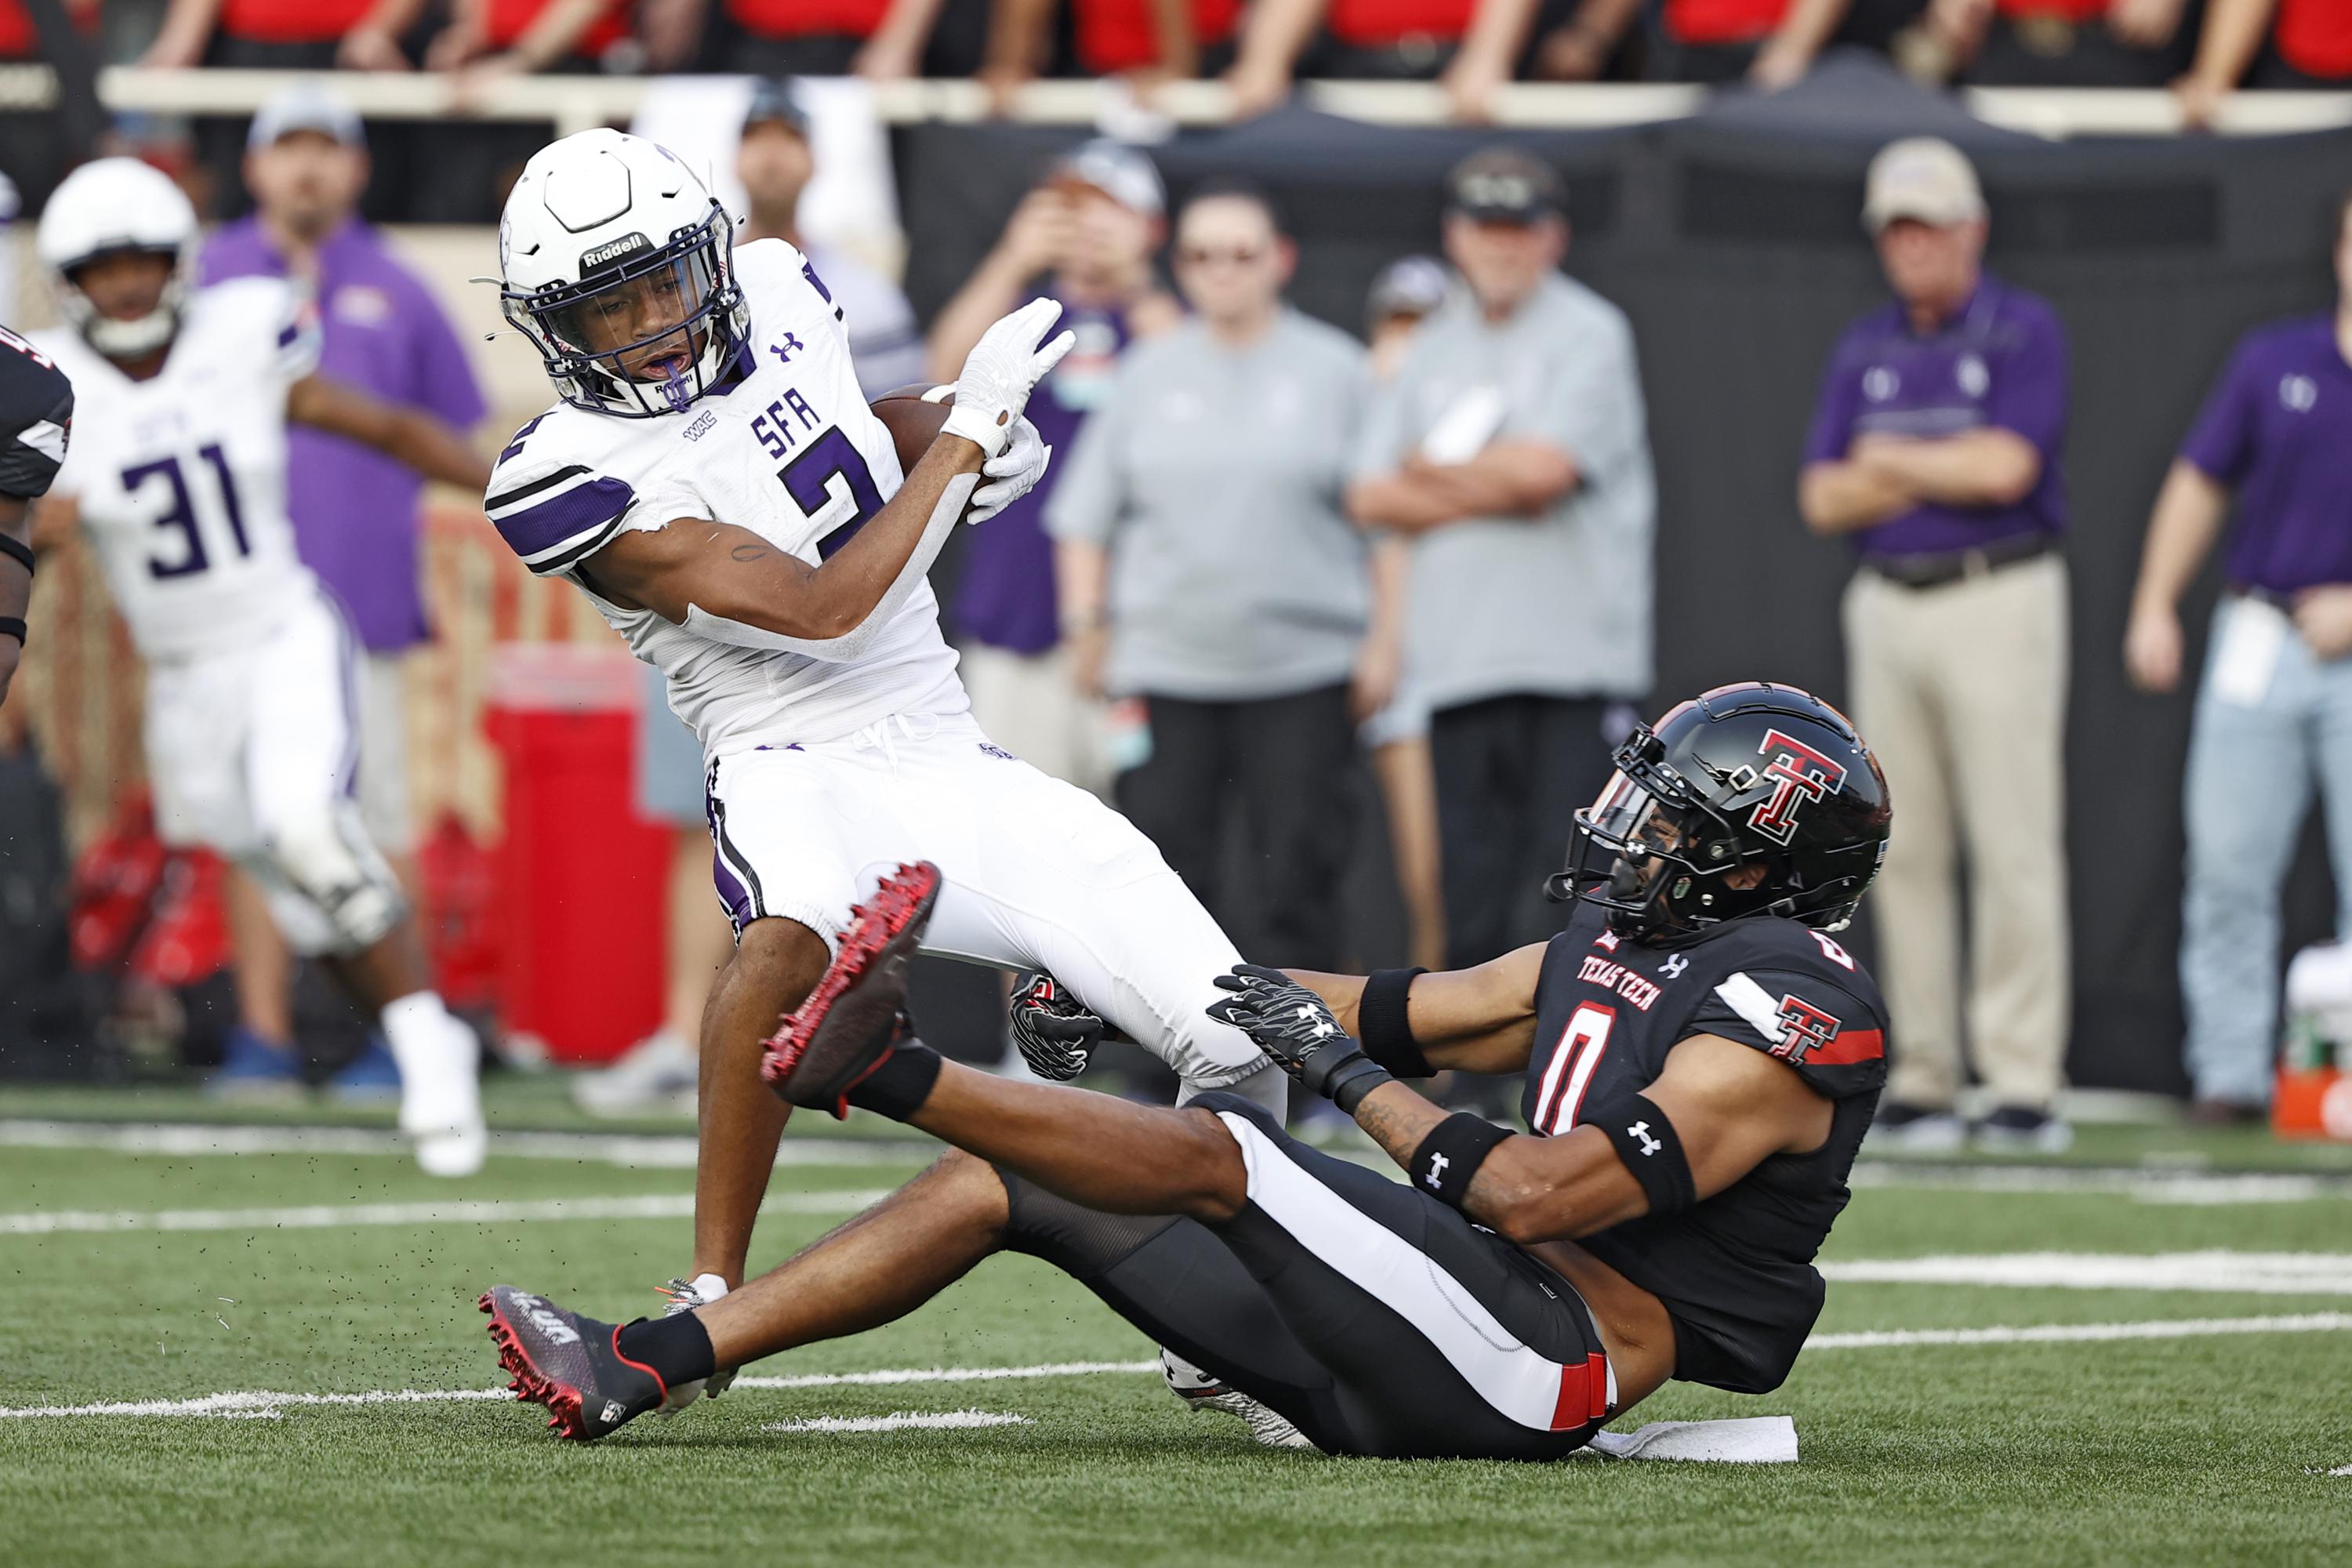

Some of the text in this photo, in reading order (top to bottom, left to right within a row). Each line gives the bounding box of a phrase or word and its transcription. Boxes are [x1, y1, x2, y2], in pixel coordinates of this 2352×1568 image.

[582, 234, 642, 268] Riddell
[683, 410, 717, 441] WAC
[750, 387, 821, 460] SFA
[121, 443, 250, 579] 31
[776, 424, 886, 564] 2
[1576, 954, 1663, 1013] TEXAS TECH
[1533, 1000, 1617, 1137] 0
